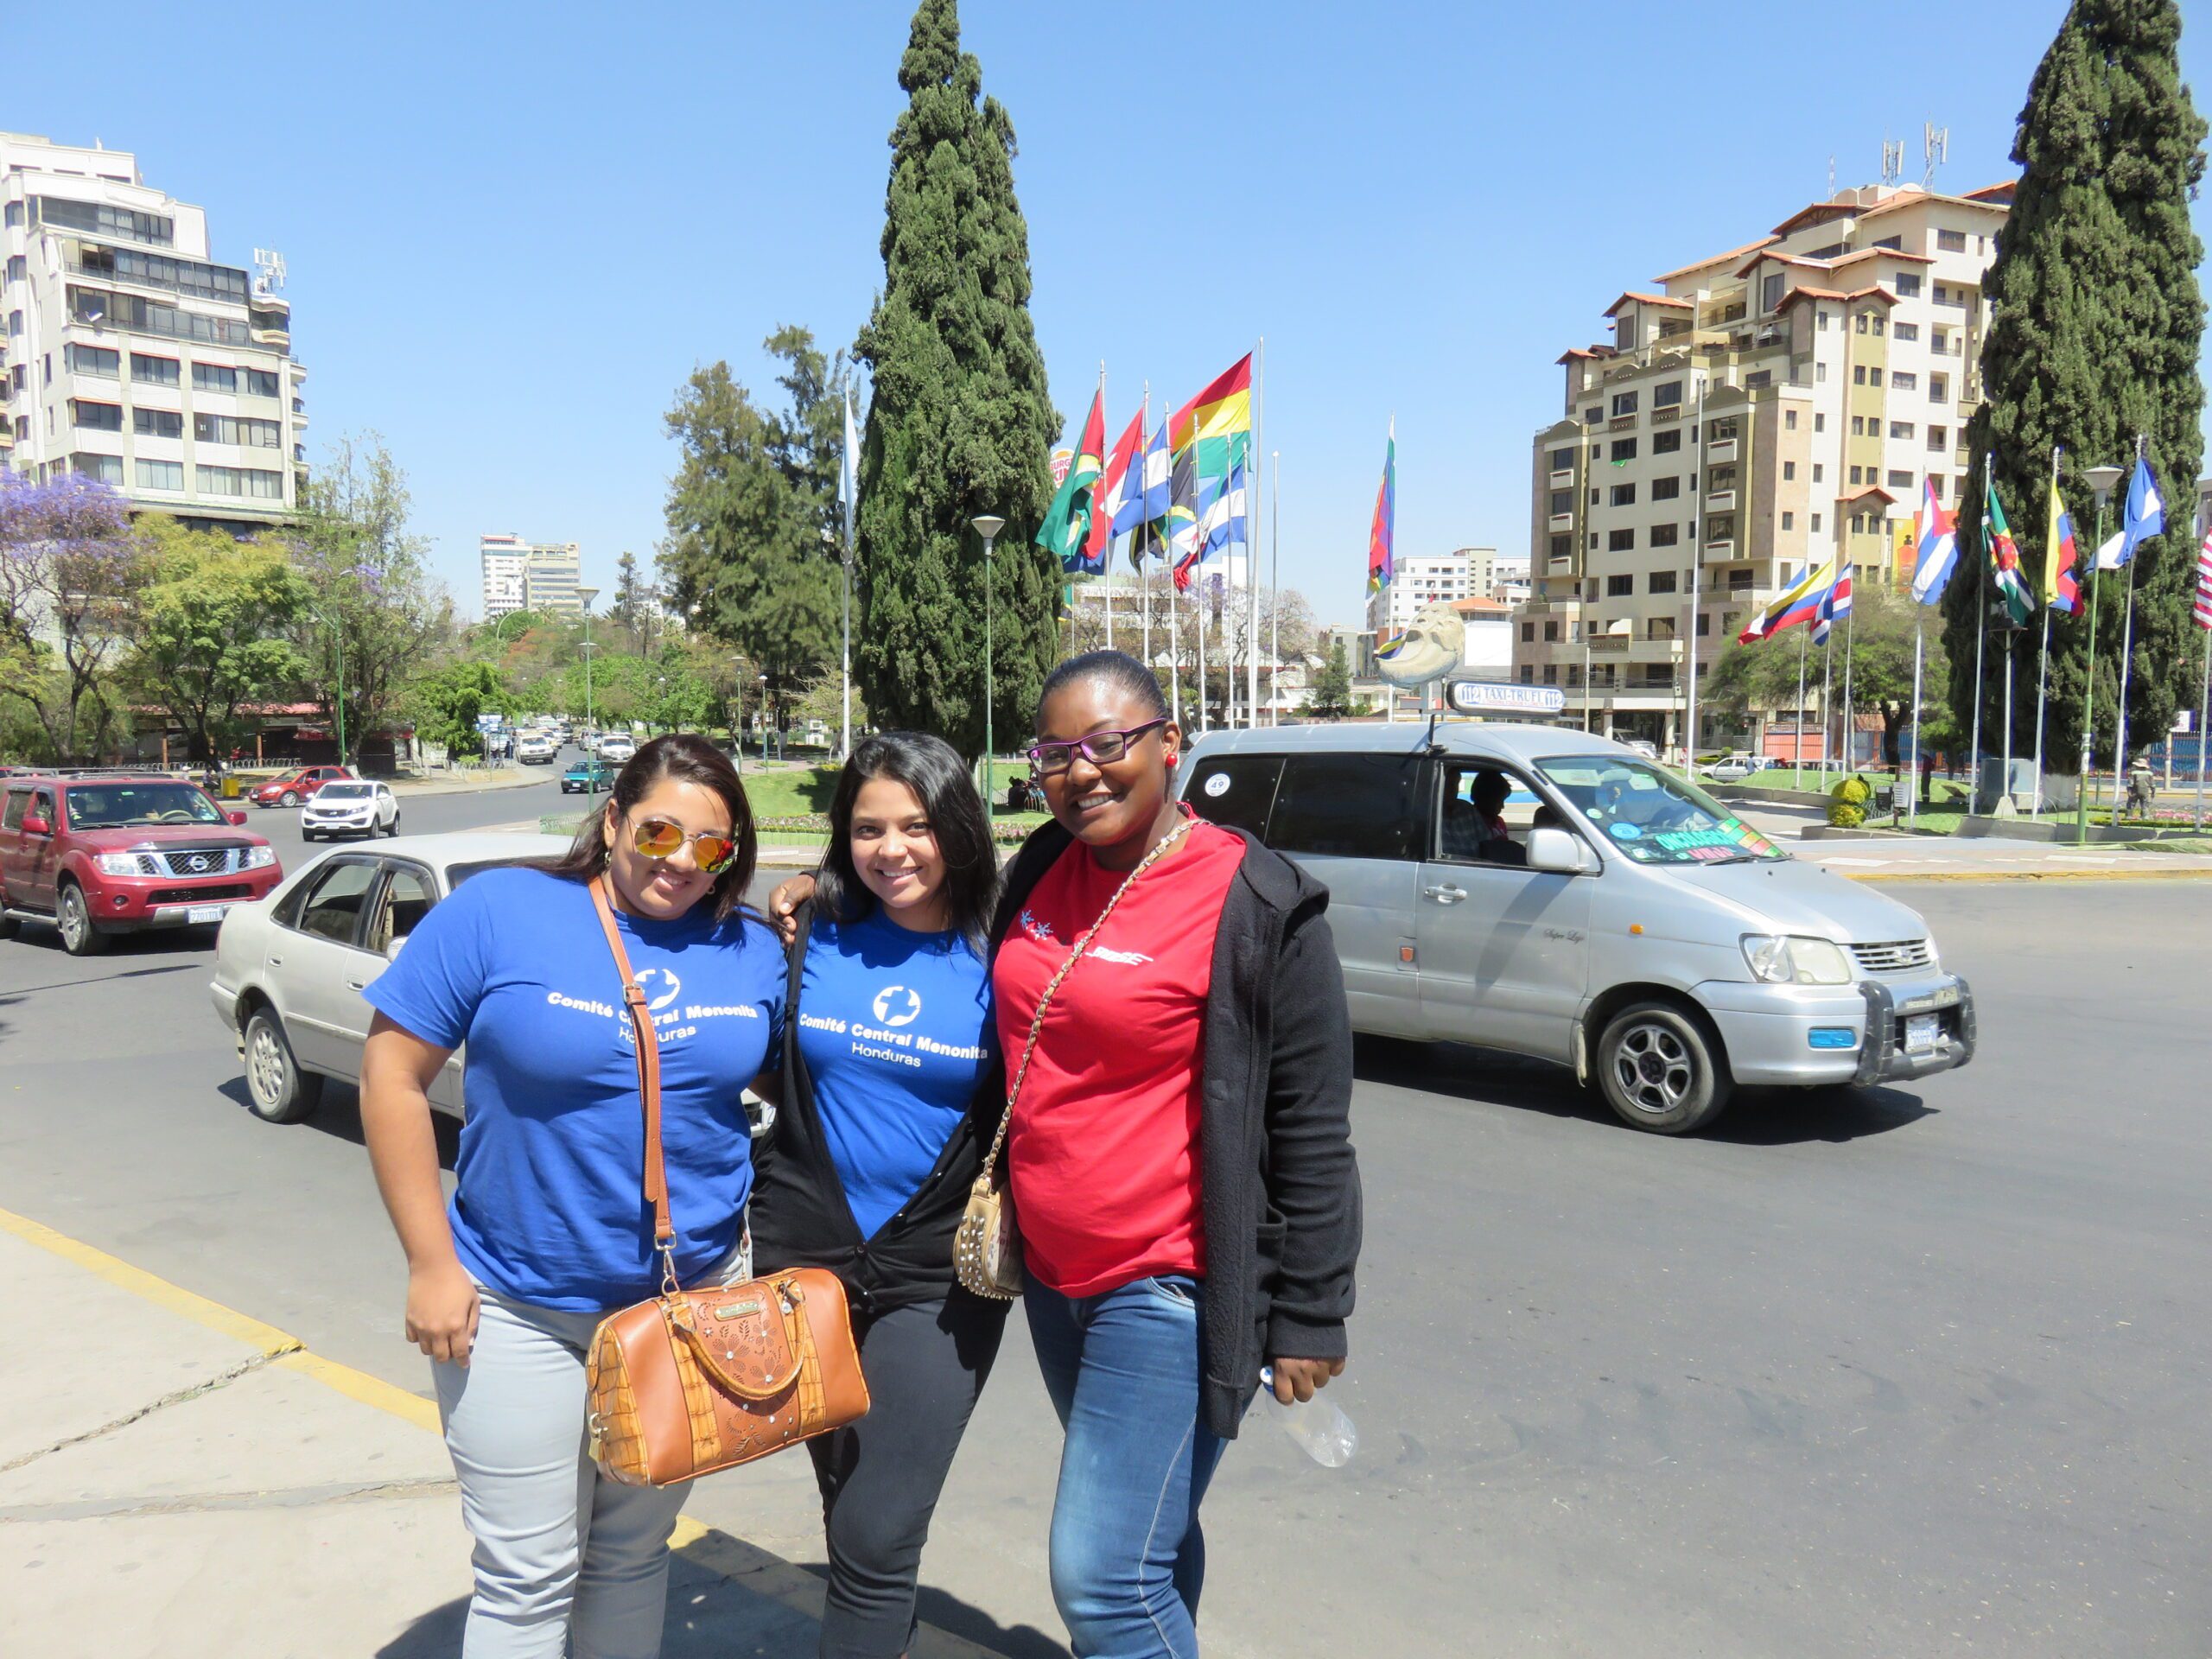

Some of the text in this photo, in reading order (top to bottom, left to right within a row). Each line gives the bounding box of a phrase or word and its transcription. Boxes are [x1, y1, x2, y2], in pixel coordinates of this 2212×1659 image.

[1463, 685, 1479, 703] 112
[1484, 688, 1541, 702] TAXI-TRUFI
[1546, 691, 1563, 708] 112
[547, 991, 614, 1018] Comité
[685, 1004, 759, 1020] Menonita
[619, 1026, 697, 1044] Houras
[799, 1013, 988, 1059] Comité Central Menonita
[851, 1041, 922, 1068] Honduras
